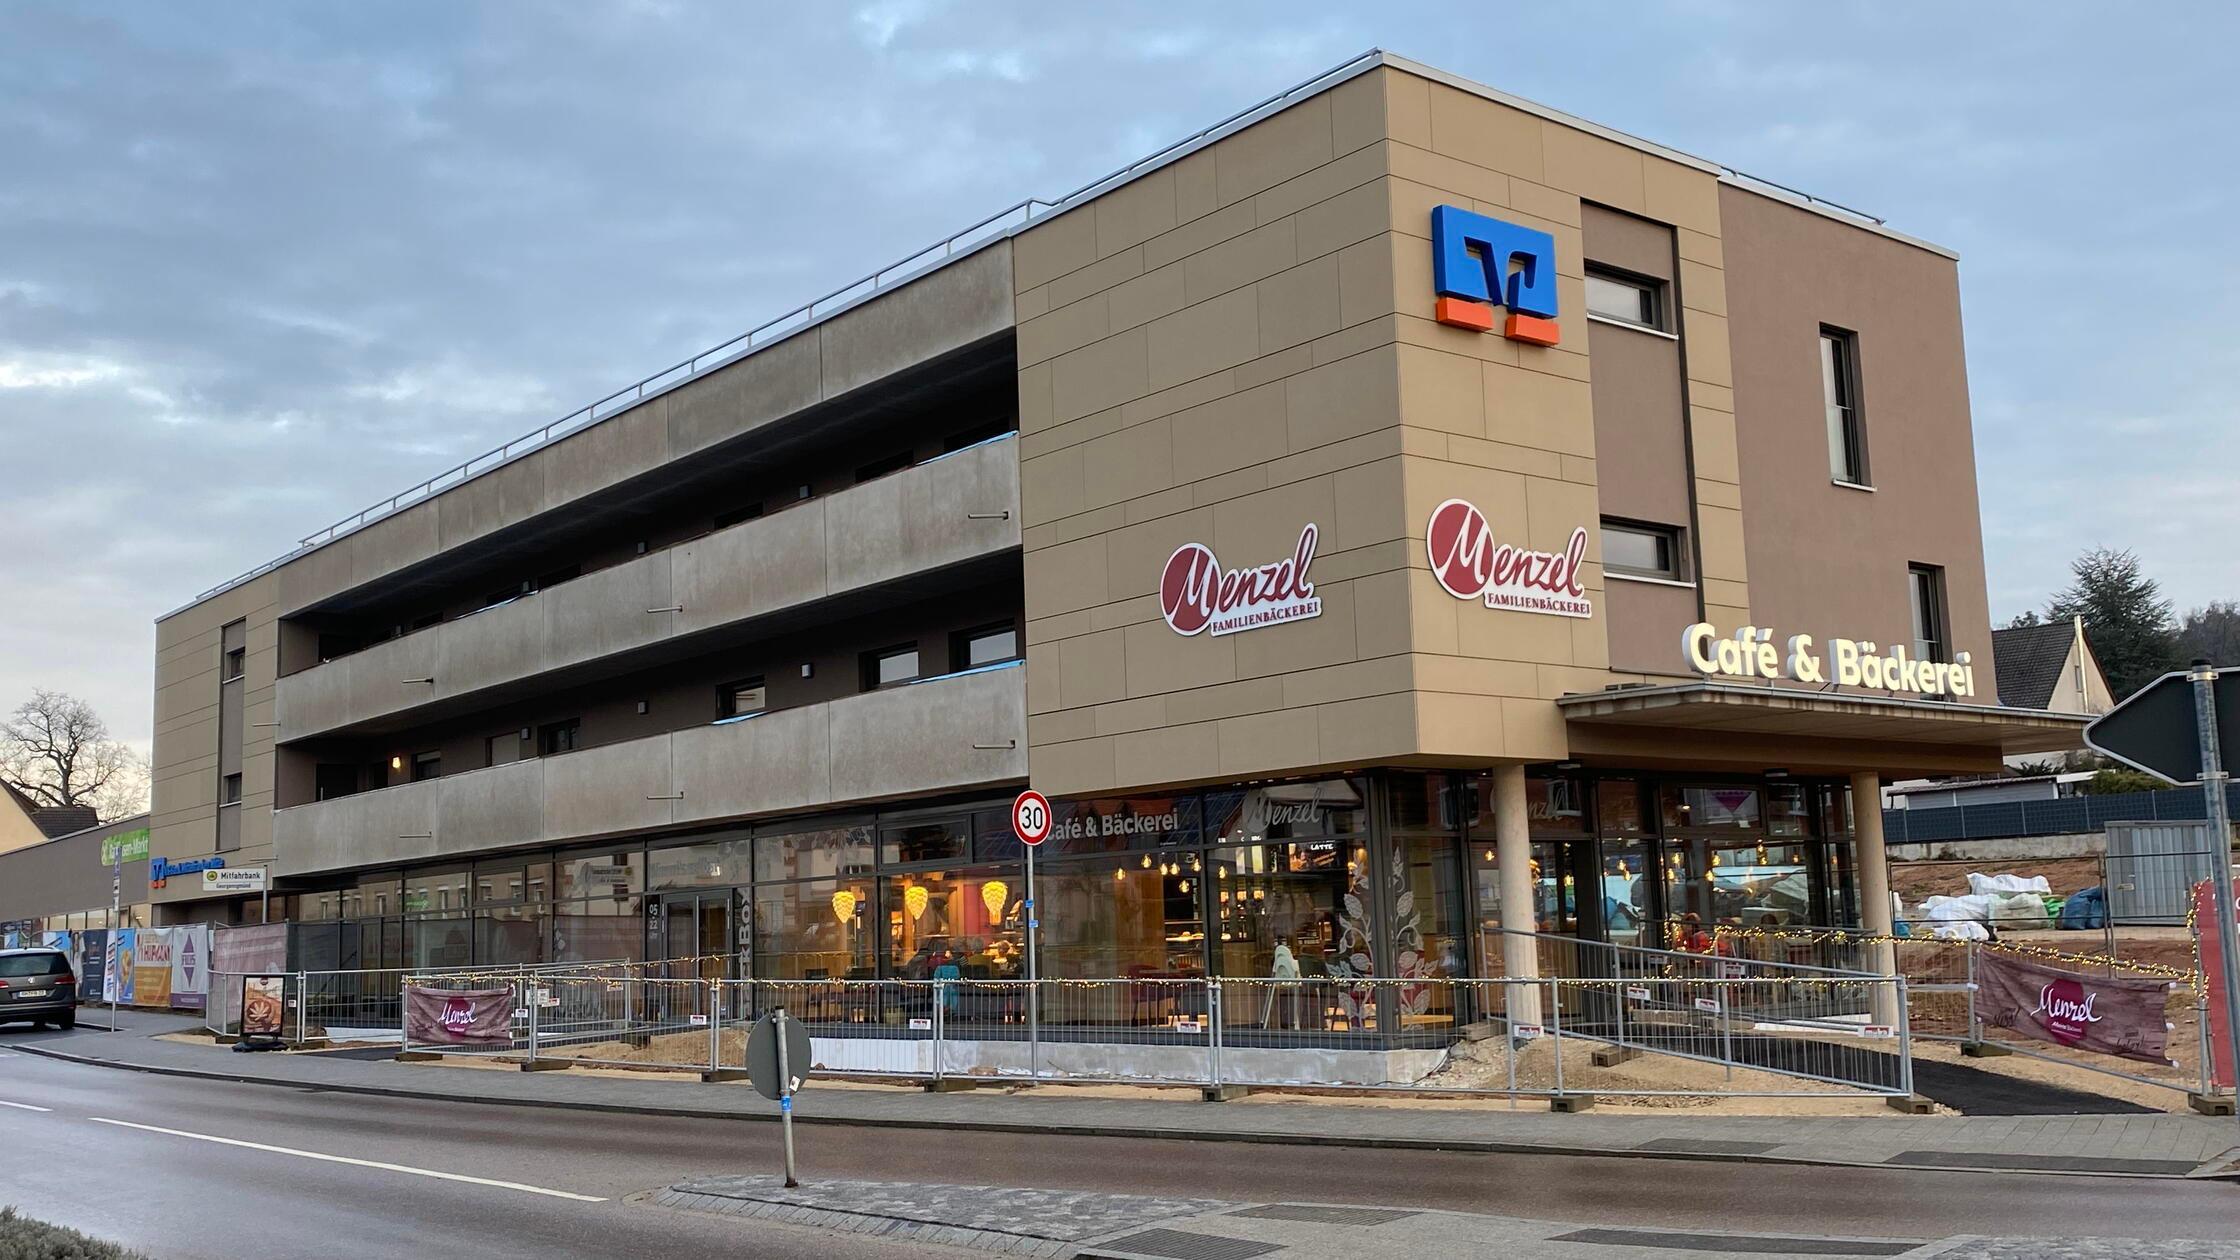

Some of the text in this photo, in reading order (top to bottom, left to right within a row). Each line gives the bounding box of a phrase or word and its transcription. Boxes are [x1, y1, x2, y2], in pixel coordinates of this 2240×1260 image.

[1437, 505, 1586, 598] Menzel
[1167, 527, 1314, 622] Menzel
[1212, 601, 1319, 633] FAMILIENBÄCKEREI
[1488, 592, 1591, 615] FAMILIENBÄCKEREI
[1682, 621, 1975, 697] Café & Bäckerei
[1021, 806, 1043, 830] 30
[1247, 785, 1321, 827] Menzel
[1085, 816, 1099, 838] &
[1101, 808, 1178, 836] Bäckerei
[1310, 843, 1334, 851] LATTE
[220, 872, 261, 880] Mitfahrbank
[438, 1002, 477, 1025] Menzel
[2031, 984, 2103, 1023] Menzel
